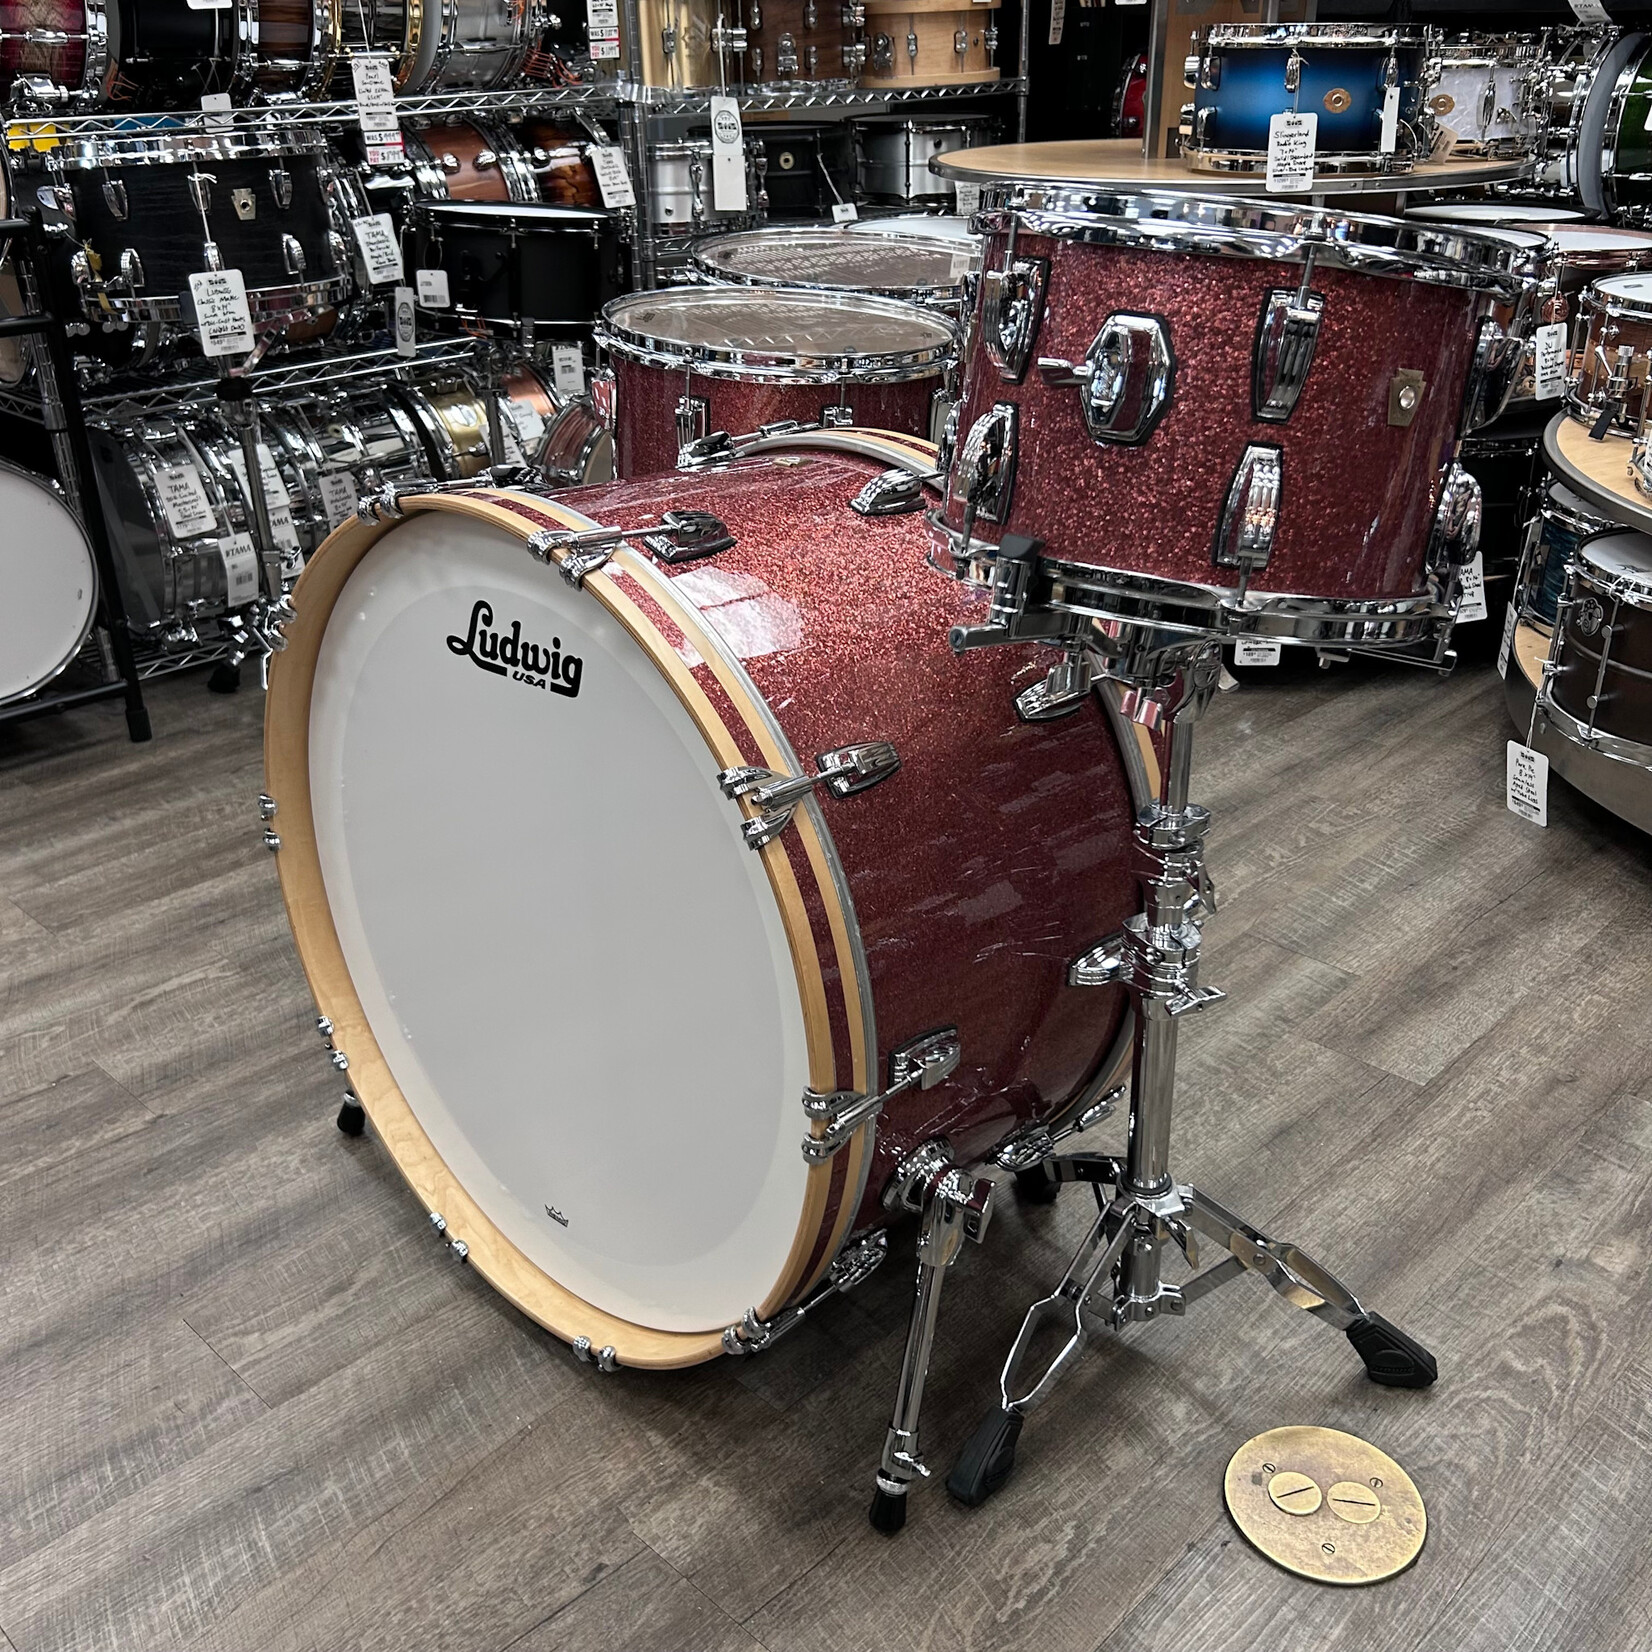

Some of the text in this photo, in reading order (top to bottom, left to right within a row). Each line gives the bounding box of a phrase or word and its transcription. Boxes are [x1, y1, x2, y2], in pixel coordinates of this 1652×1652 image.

[1274, 130, 1310, 141] Slingerland
[1294, 140, 1307, 148] King
[167, 482, 190, 493] TAMA
[329, 487, 346, 497] TAMA
[271, 516, 290, 528] AMA
[230, 544, 252, 556] TAMA
[447, 600, 583, 698] Ludwig
[512, 670, 546, 690] USA
